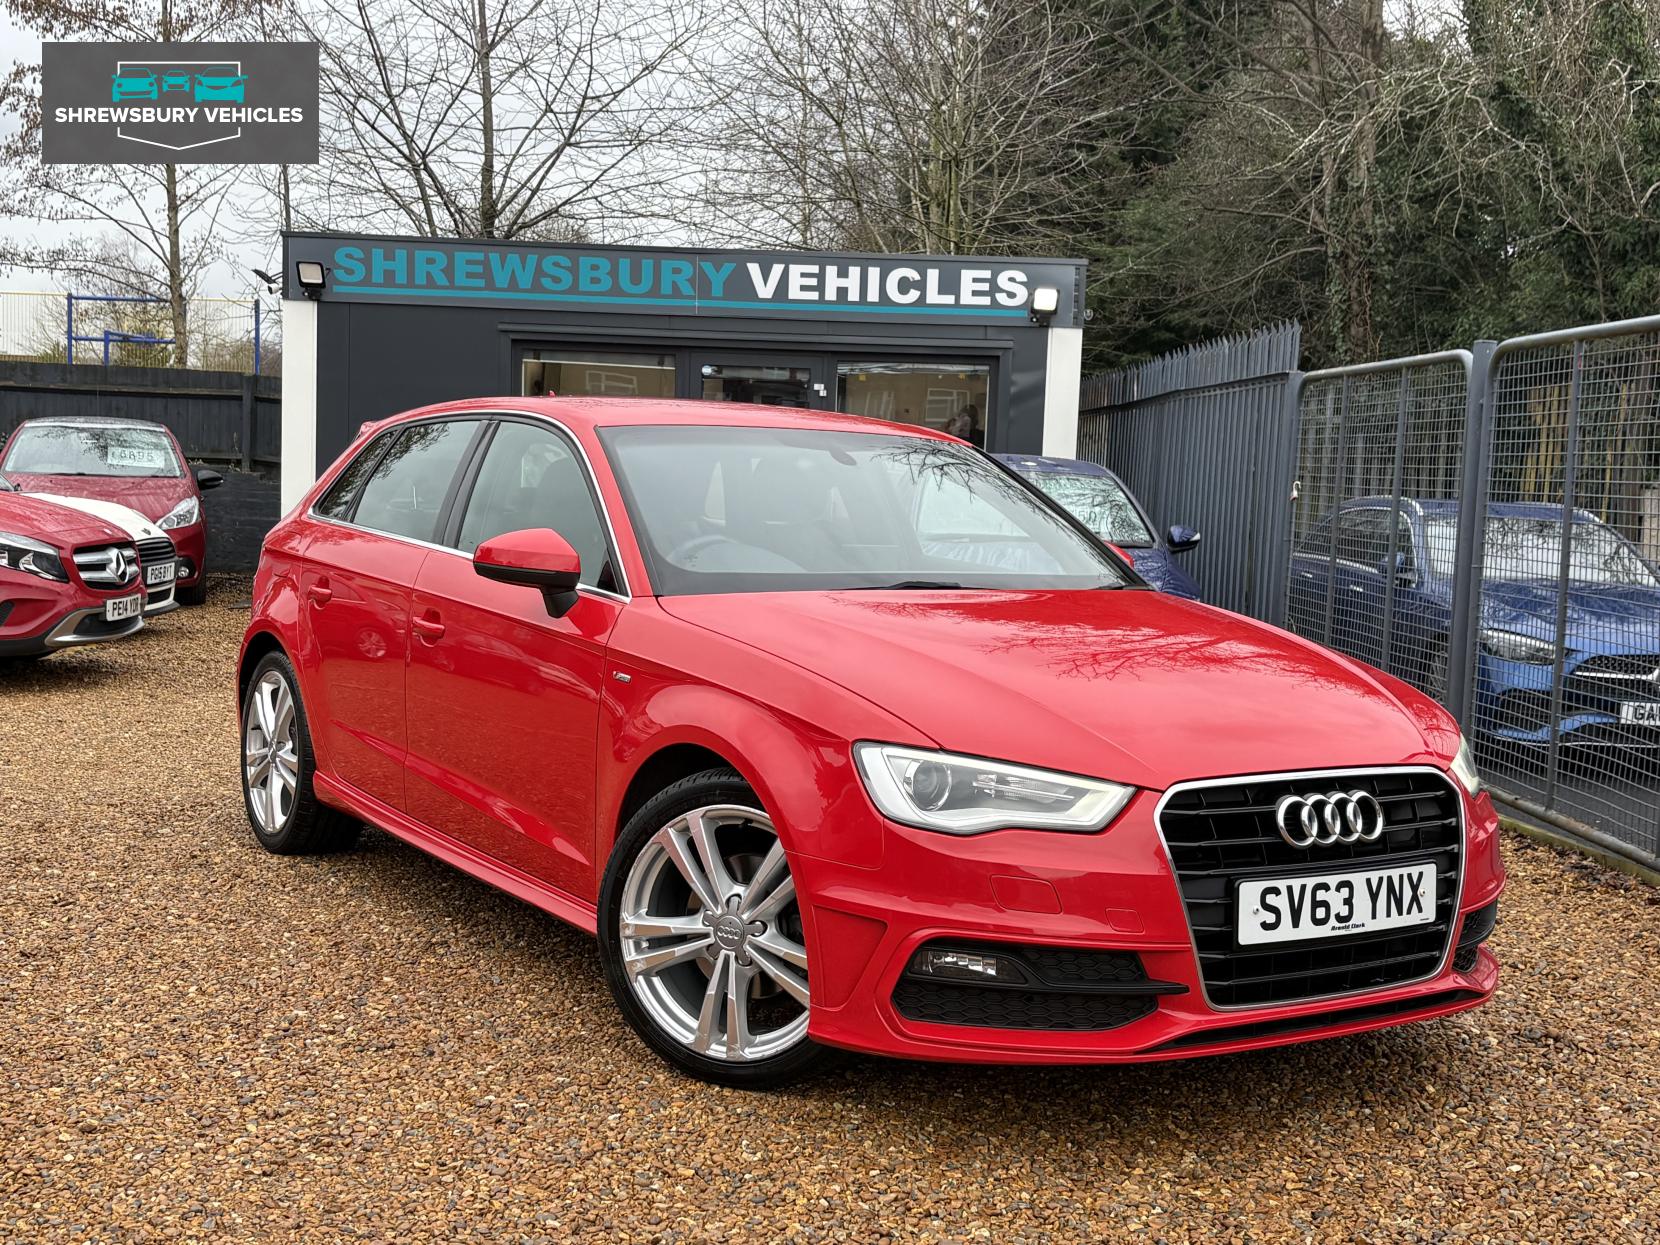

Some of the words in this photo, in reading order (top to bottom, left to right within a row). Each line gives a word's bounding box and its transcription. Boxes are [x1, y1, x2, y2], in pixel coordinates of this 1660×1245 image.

[332, 247, 737, 297] SHREWSBURY
[746, 263, 1029, 307] VEHICLES
[112, 599, 128, 617] PE14
[1259, 880, 1354, 931] SV63
[1366, 871, 1424, 920] YNX
